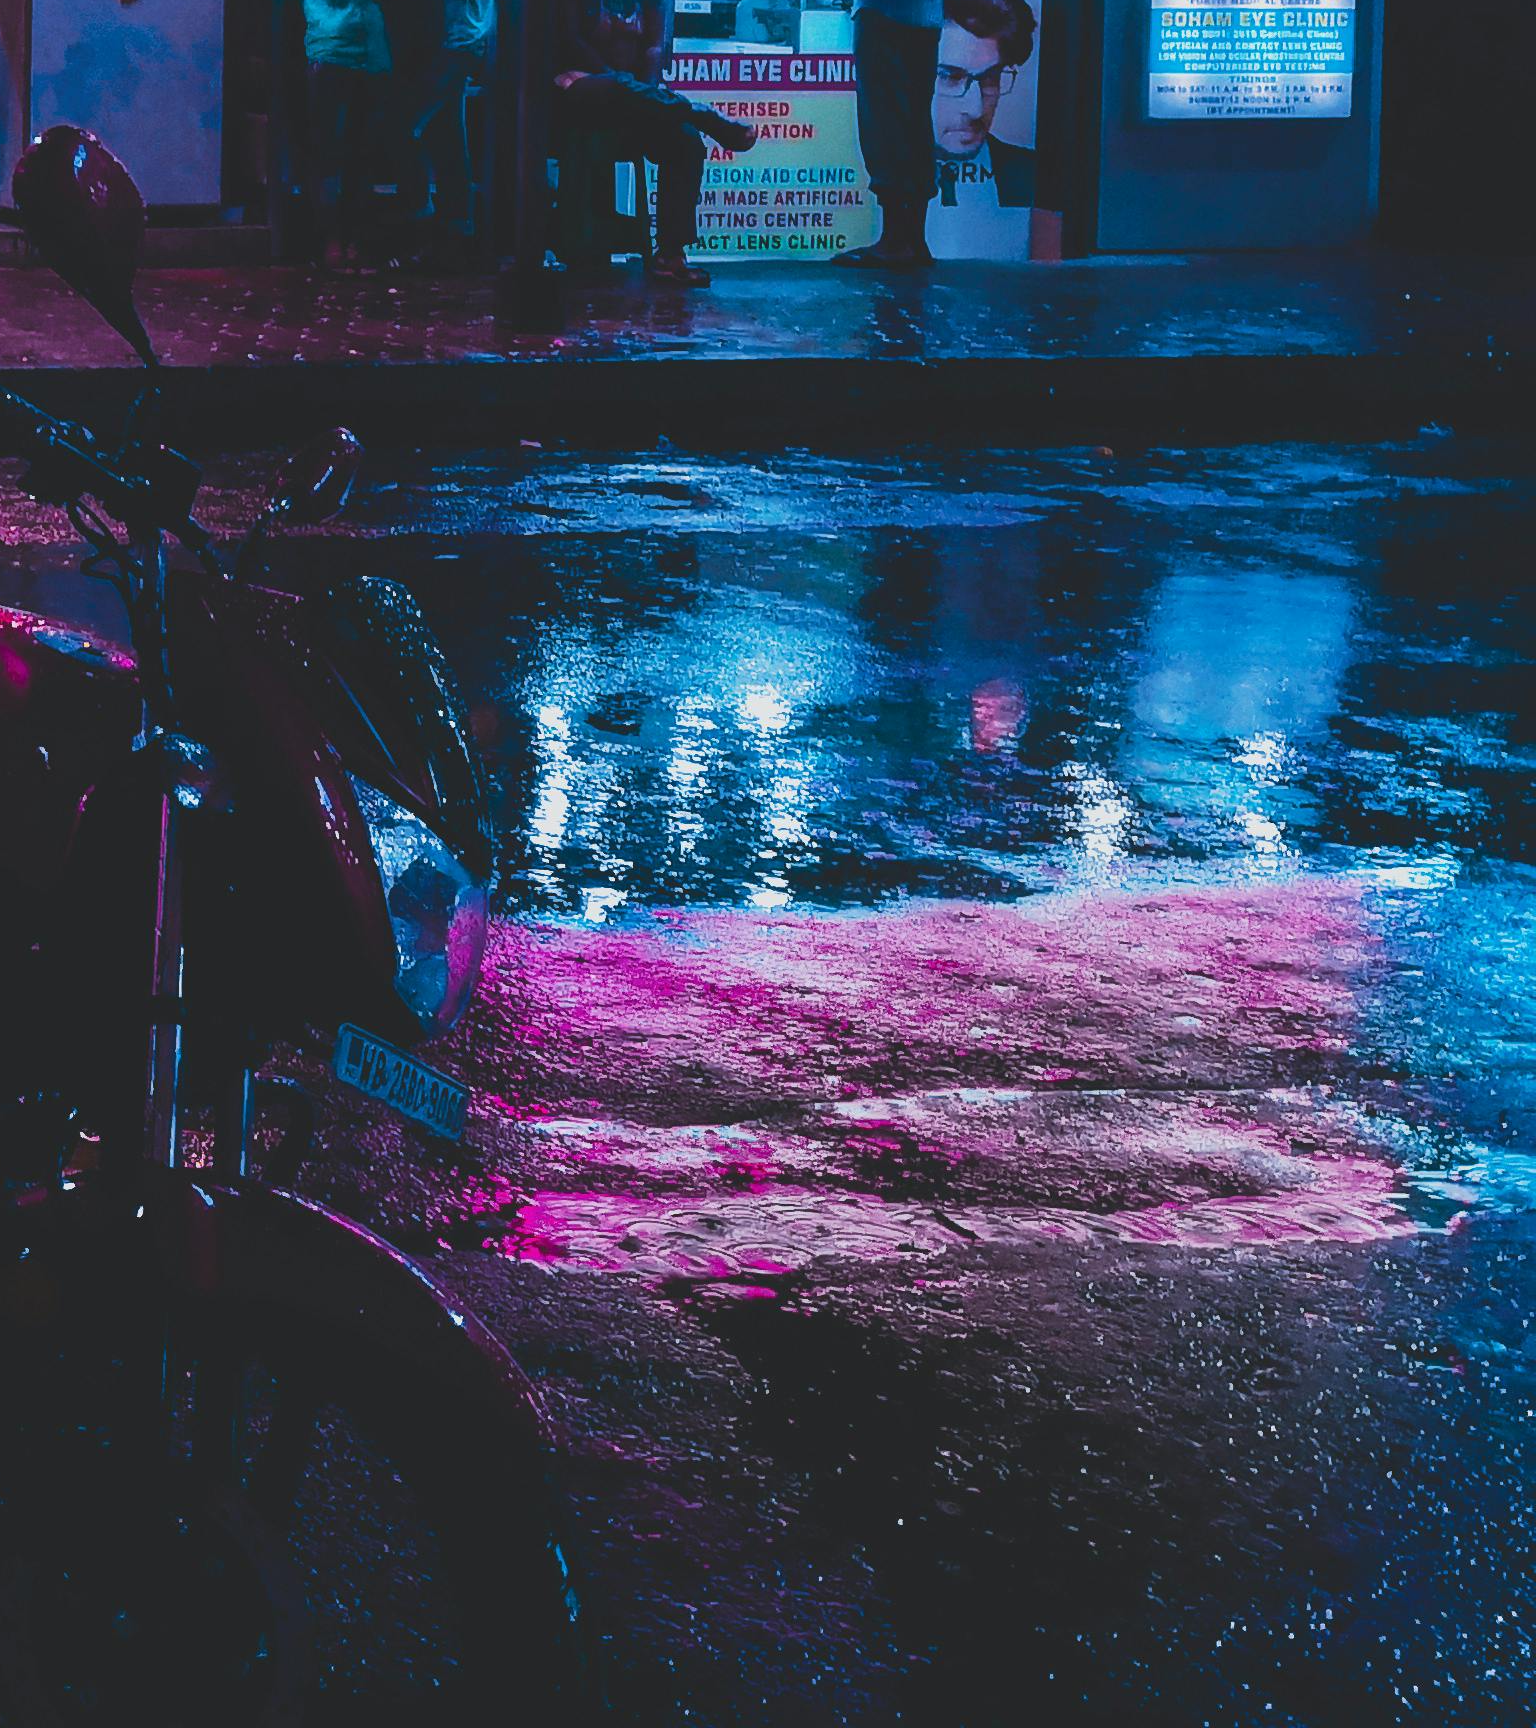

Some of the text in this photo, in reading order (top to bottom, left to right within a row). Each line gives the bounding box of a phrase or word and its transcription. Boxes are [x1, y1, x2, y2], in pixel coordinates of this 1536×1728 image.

[1161, 12, 1349, 27] SOHAM EYE CLINIC
[739, 59, 782, 82] EYE
[789, 59, 857, 82] CLINI
[706, 168, 856, 184] ISION AID CLINIC
[723, 191, 864, 205] MADE ARTIFICIAL
[699, 213, 833, 228] ITTING CENTRE
[737, 235, 782, 250] LENS
[788, 235, 847, 250] CLINIC
